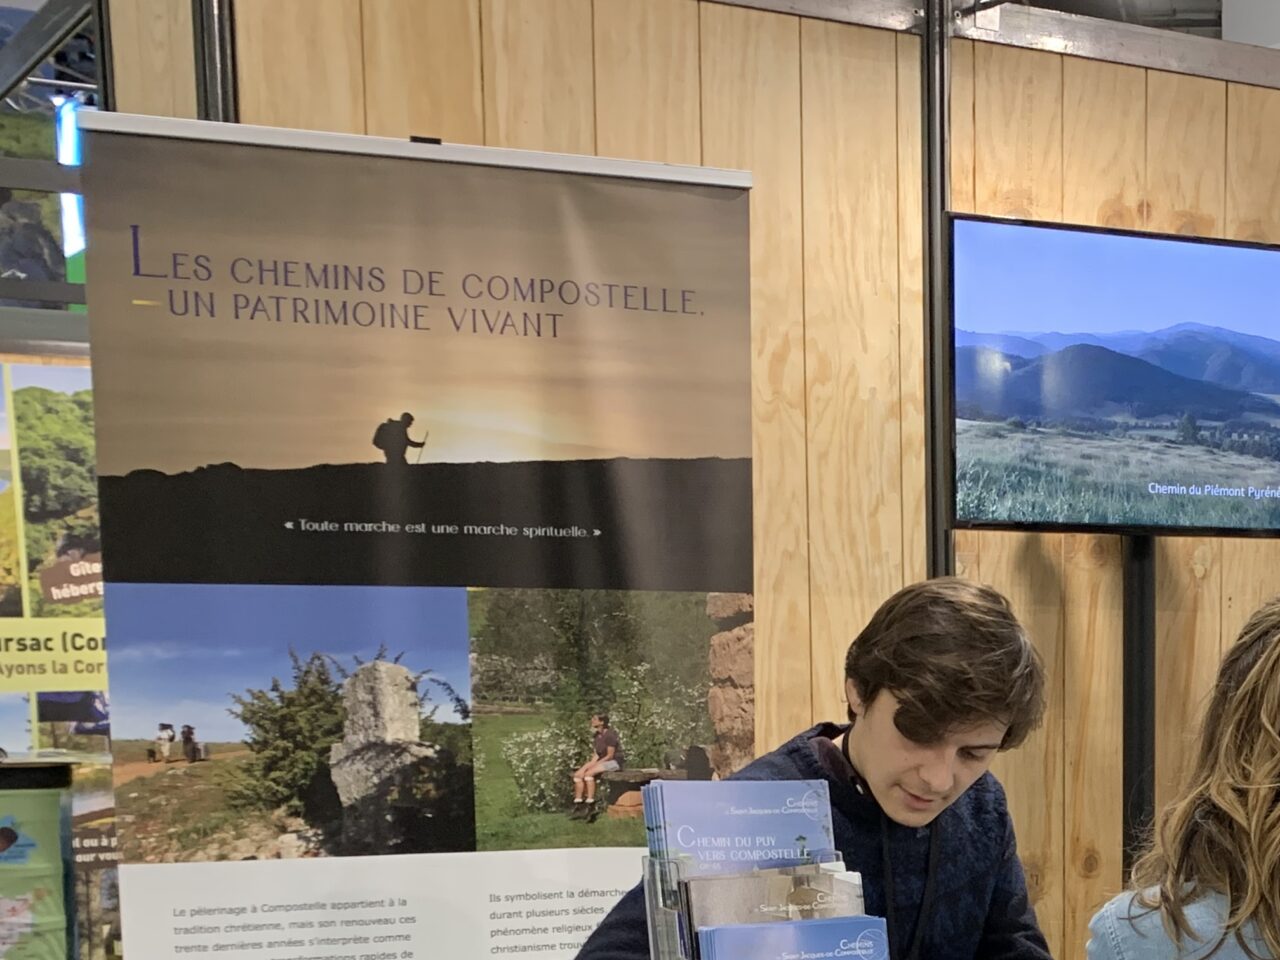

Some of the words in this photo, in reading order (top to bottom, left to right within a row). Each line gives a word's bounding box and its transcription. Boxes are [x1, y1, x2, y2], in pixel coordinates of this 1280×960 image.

[130, 224, 213, 281] LES
[230, 257, 387, 293] CHEMINS
[403, 269, 446, 297] DE
[462, 273, 705, 316] COMPOSTELLE.
[168, 289, 216, 318] UN
[233, 293, 431, 331] PATRIMOINE
[447, 306, 564, 338] VIVANT
[1148, 482, 1187, 495] Chemin
[1189, 484, 1202, 496] du
[1205, 484, 1246, 498] Piémont
[299, 518, 339, 532] Toute
[344, 520, 400, 533] marche
[405, 522, 426, 534] est
[432, 523, 459, 535] une
[464, 523, 518, 536] marche
[0, 637, 54, 652] rsac
[52, 660, 68, 675] la
[735, 836, 752, 848] DU
[756, 835, 776, 847] PUY
[698, 849, 726, 861] VERS
[730, 848, 811, 860] COMPOSTELLE
[489, 893, 501, 903] Ils
[504, 890, 564, 903] symbolisent
[566, 889, 575, 899] la
[173, 908, 186, 917] Le
[489, 910, 523, 920] durant
[526, 907, 570, 919] plusieurs
[340, 917, 396, 927] renouveau
[399, 915, 416, 924] ces
[490, 926, 549, 938] phénomène
[552, 923, 592, 934] religieux
[373, 934, 412, 943] comme
[359, 951, 398, 960] rapides
[400, 950, 413, 959] de
[490, 943, 557, 954] christianisme
